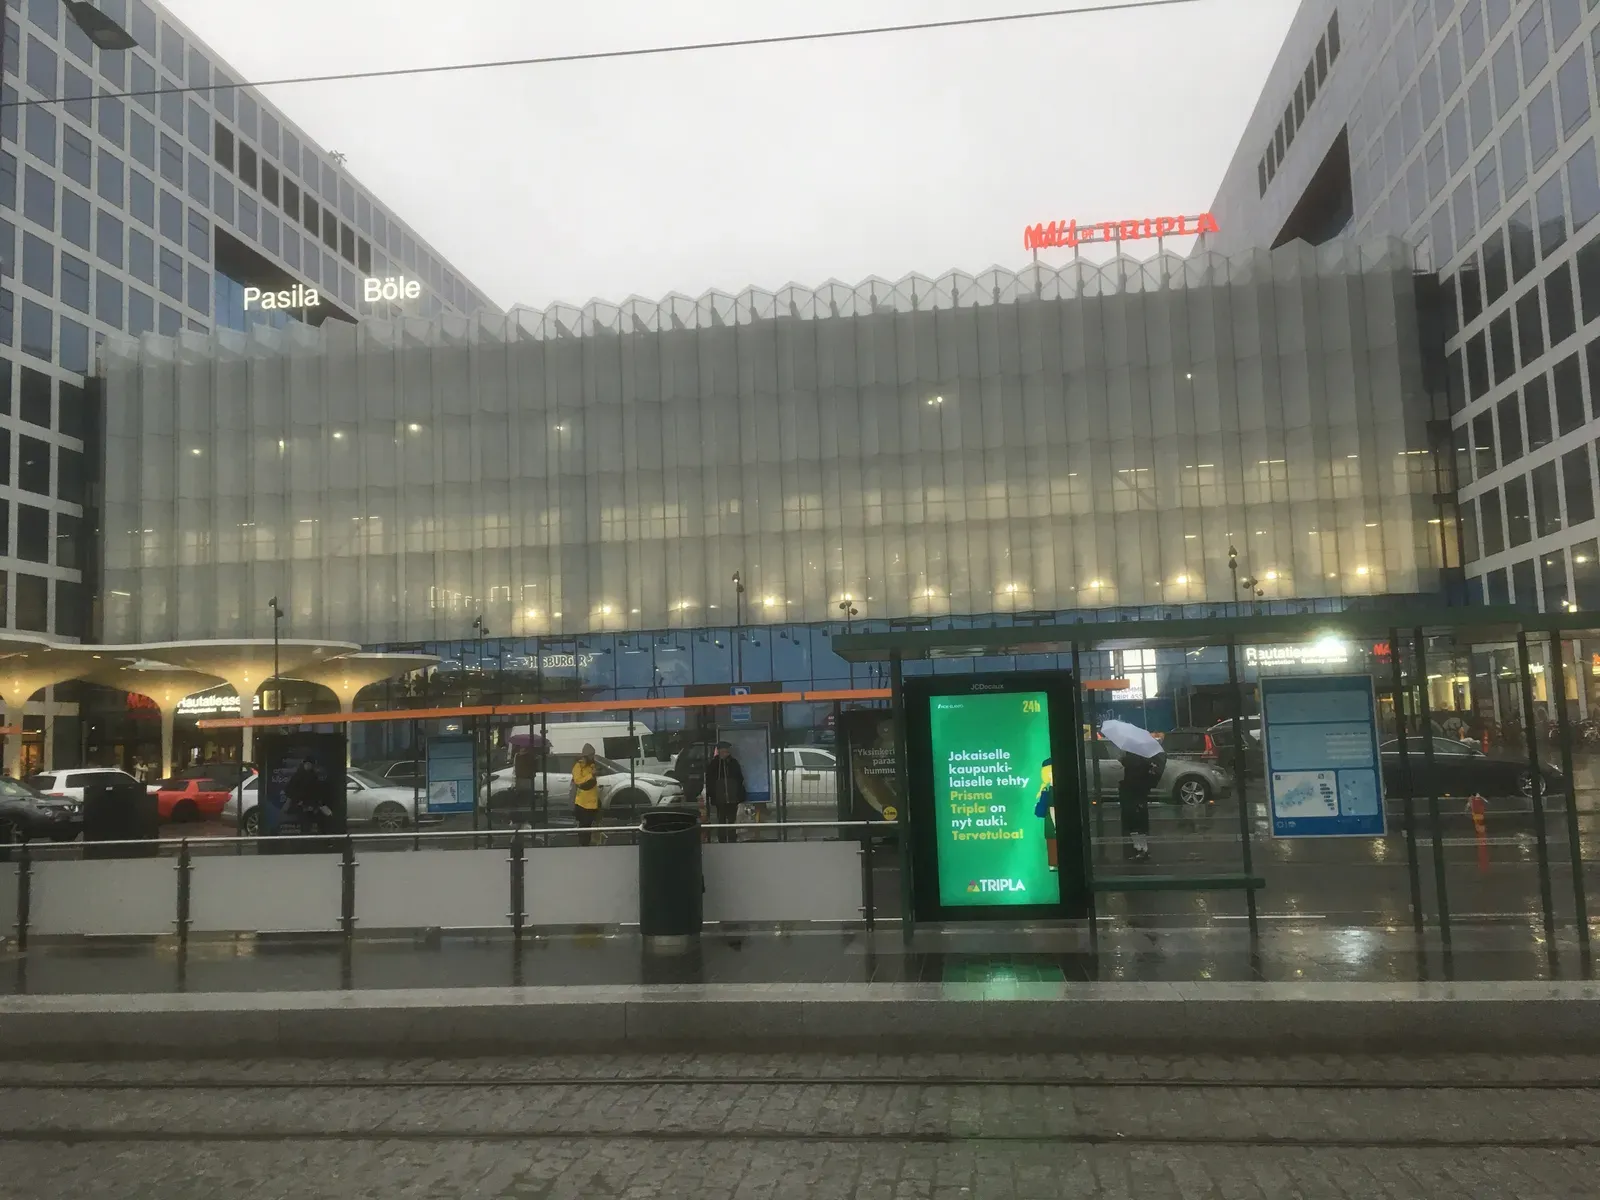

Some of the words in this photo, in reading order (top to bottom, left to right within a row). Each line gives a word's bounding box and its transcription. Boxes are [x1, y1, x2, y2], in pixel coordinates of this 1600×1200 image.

[1024, 219, 1079, 251] MALL
[1096, 212, 1220, 242] TRIPLA
[364, 275, 421, 303] Böle
[243, 284, 321, 311] Pasila
[528, 654, 588, 669] HSBURGR
[970, 683, 1005, 691] JCDecaux
[1022, 700, 1042, 713] 24h
[948, 748, 1011, 762] Jokaiselle
[872, 758, 896, 767] paras
[949, 761, 1013, 777] kaupunki-
[863, 767, 896, 775] hummu
[949, 775, 993, 788] laiselle
[996, 774, 1030, 788] tehty
[950, 790, 993, 801] Prisma
[950, 802, 987, 817] Tripla
[989, 804, 1006, 813] on
[951, 816, 973, 831] nyt
[975, 814, 1008, 827] auki.
[951, 828, 1024, 841] Tervetuloa!
[979, 878, 1026, 893] TRIPLA
